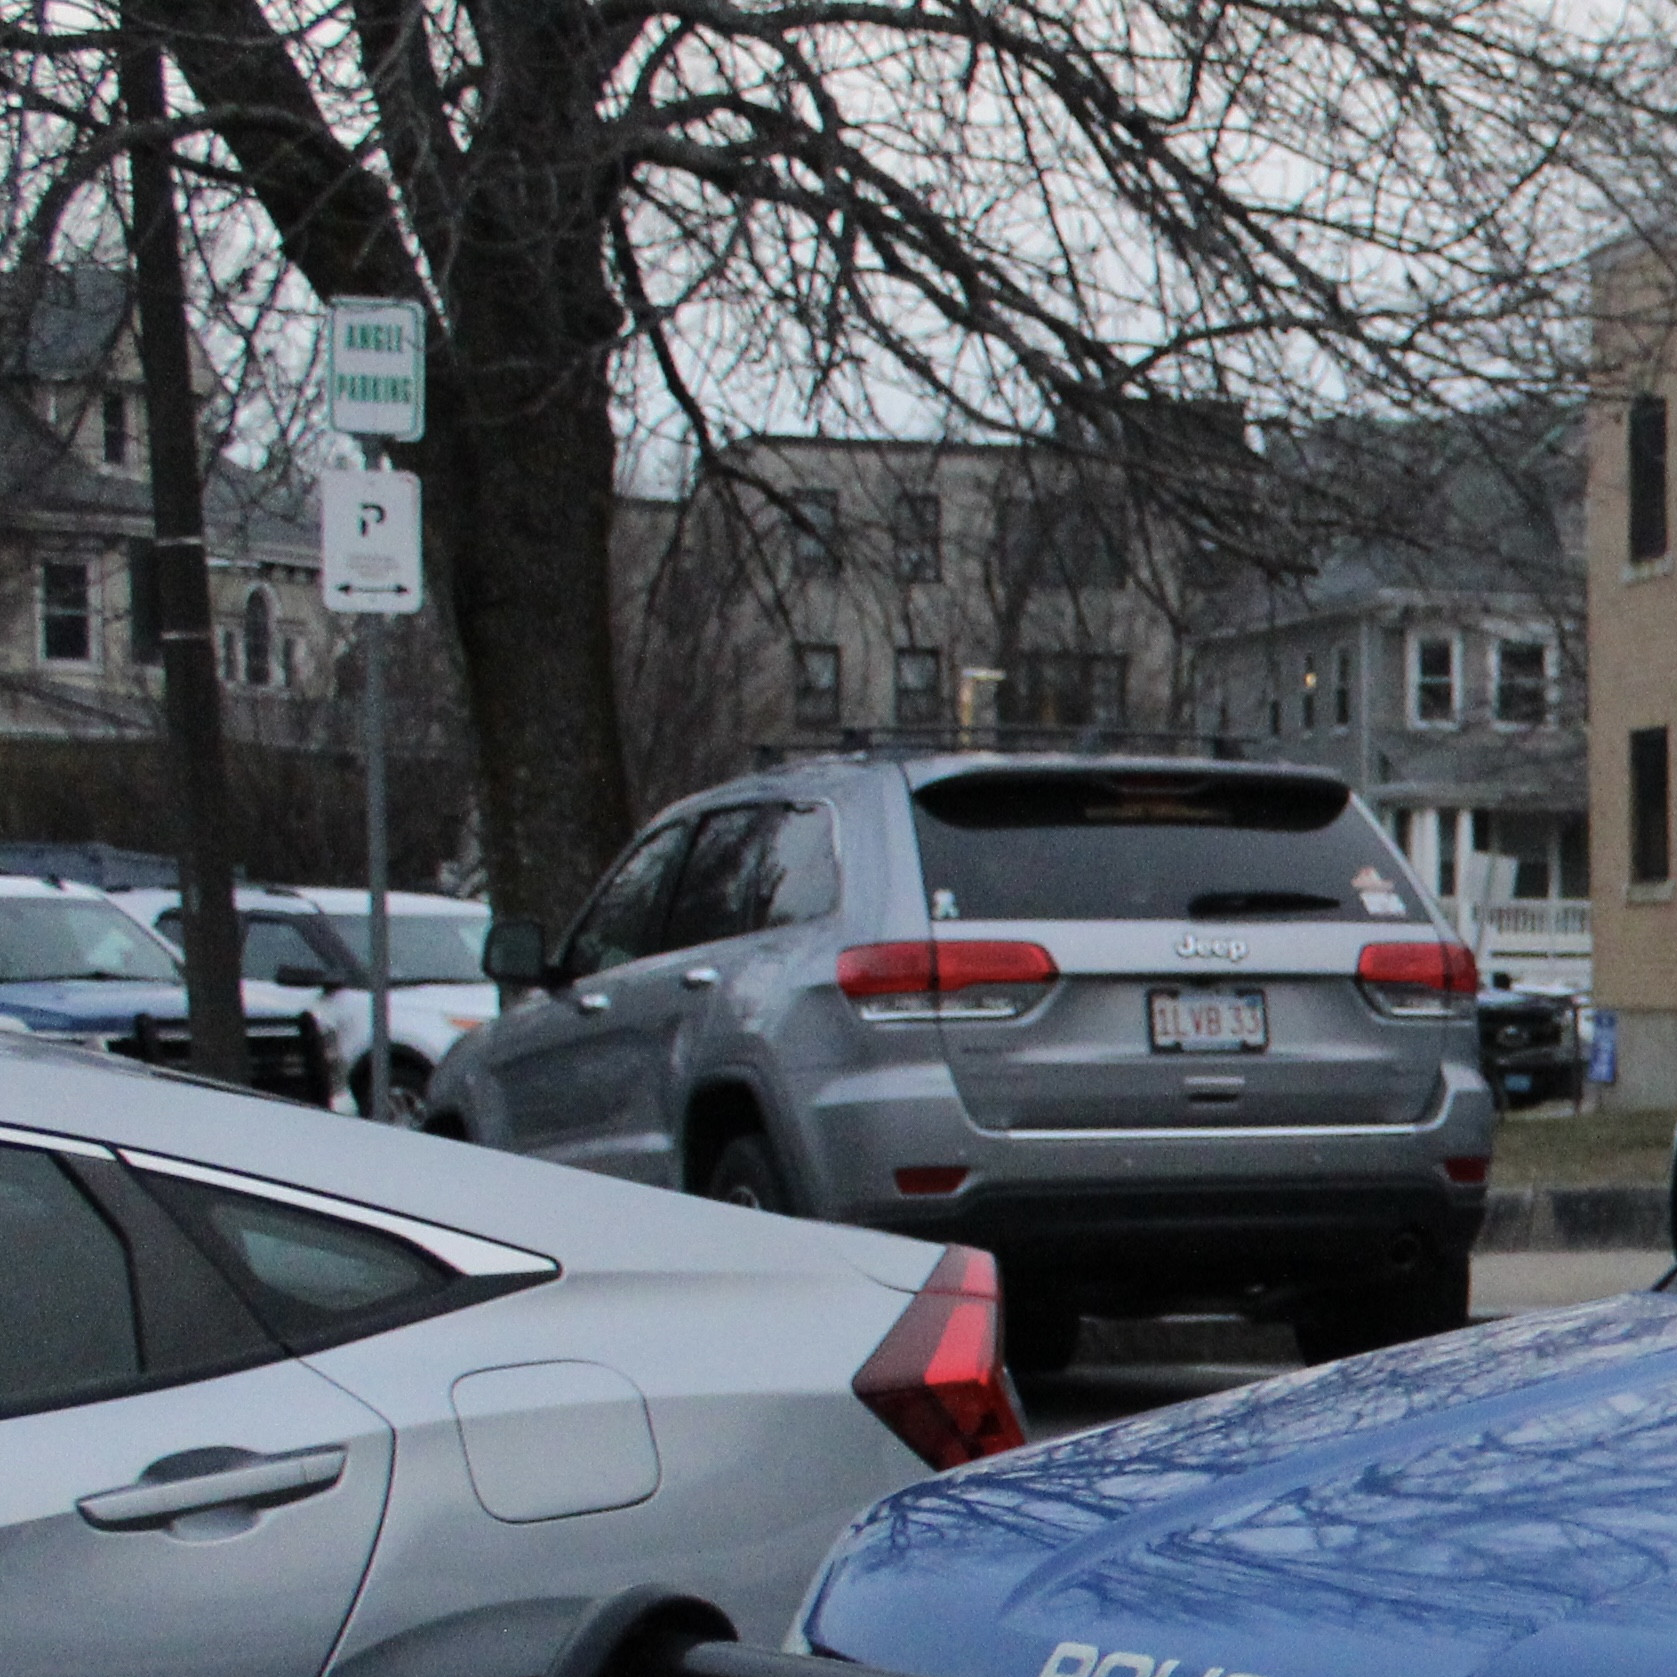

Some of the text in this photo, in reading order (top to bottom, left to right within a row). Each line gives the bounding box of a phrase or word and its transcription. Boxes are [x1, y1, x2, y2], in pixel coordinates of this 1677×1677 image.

[345, 324, 402, 352] ANGLE
[336, 374, 411, 404] PARKING
[1177, 933, 1247, 961] Jeep
